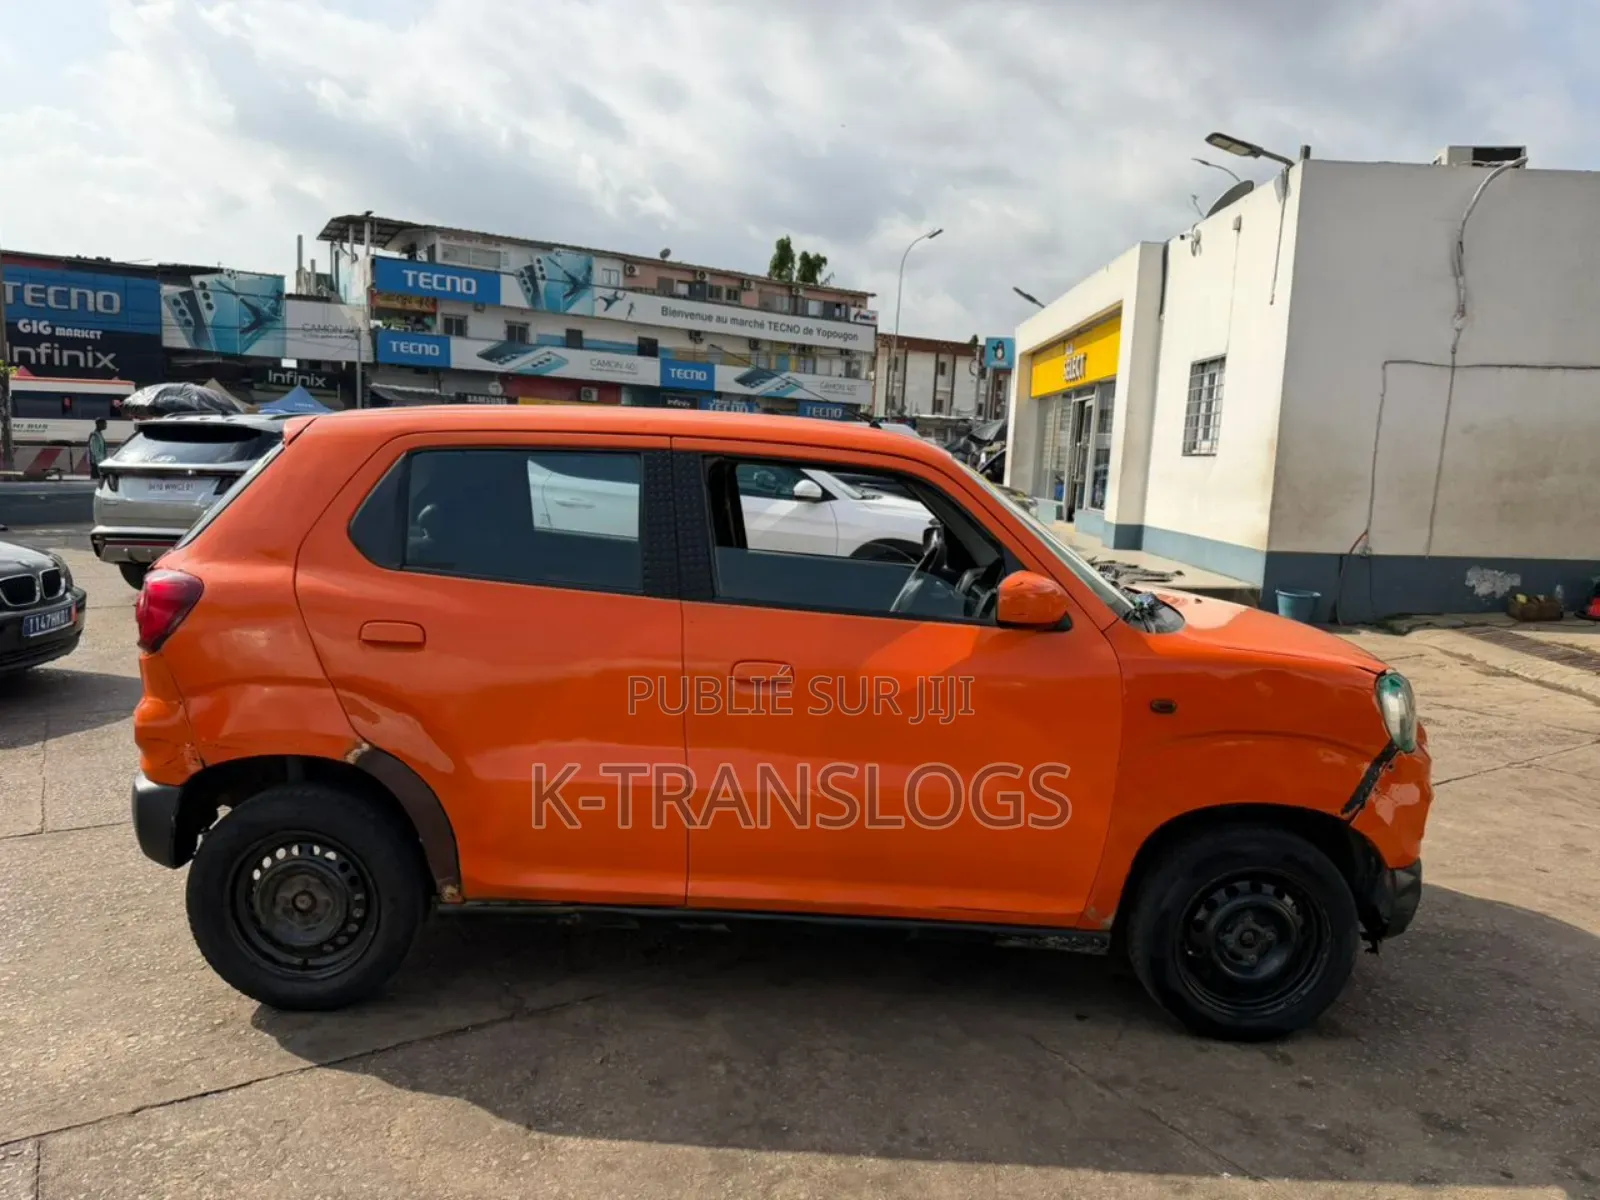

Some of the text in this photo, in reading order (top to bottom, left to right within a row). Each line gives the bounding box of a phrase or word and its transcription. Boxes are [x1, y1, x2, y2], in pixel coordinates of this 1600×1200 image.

[402, 269, 477, 295] TECNO
[3, 280, 121, 315] TECNO
[17, 318, 102, 340] GIG MARKET
[660, 305, 859, 342] Bienvenue au marché TECNO de Yopougon
[389, 340, 440, 357] TECNO
[590, 359, 622, 369] CAMON
[1064, 354, 1086, 381] SELECT
[268, 370, 327, 388] Infinix
[669, 367, 708, 381] TECNO
[708, 402, 748, 414] TECNO
[805, 406, 842, 419] TECNO
